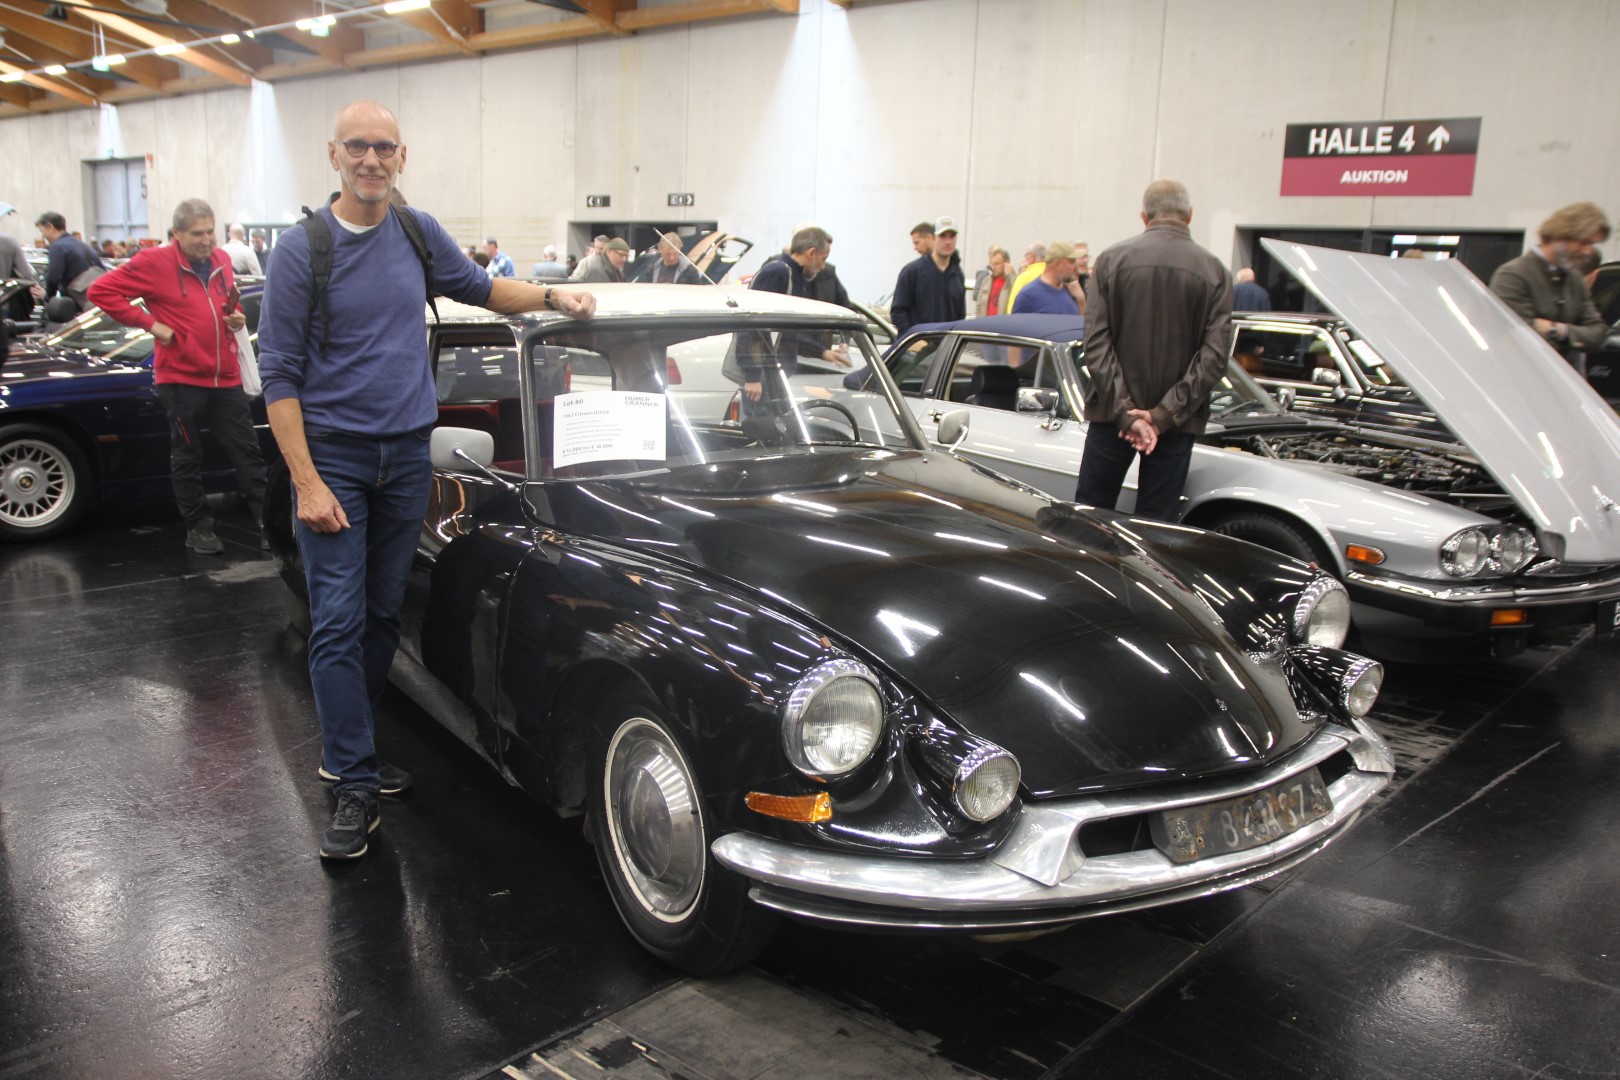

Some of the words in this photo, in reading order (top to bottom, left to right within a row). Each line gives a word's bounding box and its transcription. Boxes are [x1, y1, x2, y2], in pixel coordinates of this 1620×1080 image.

[1308, 126, 1394, 155] HALLE
[1398, 125, 1415, 153] 4
[1340, 169, 1408, 184] AUKTION
